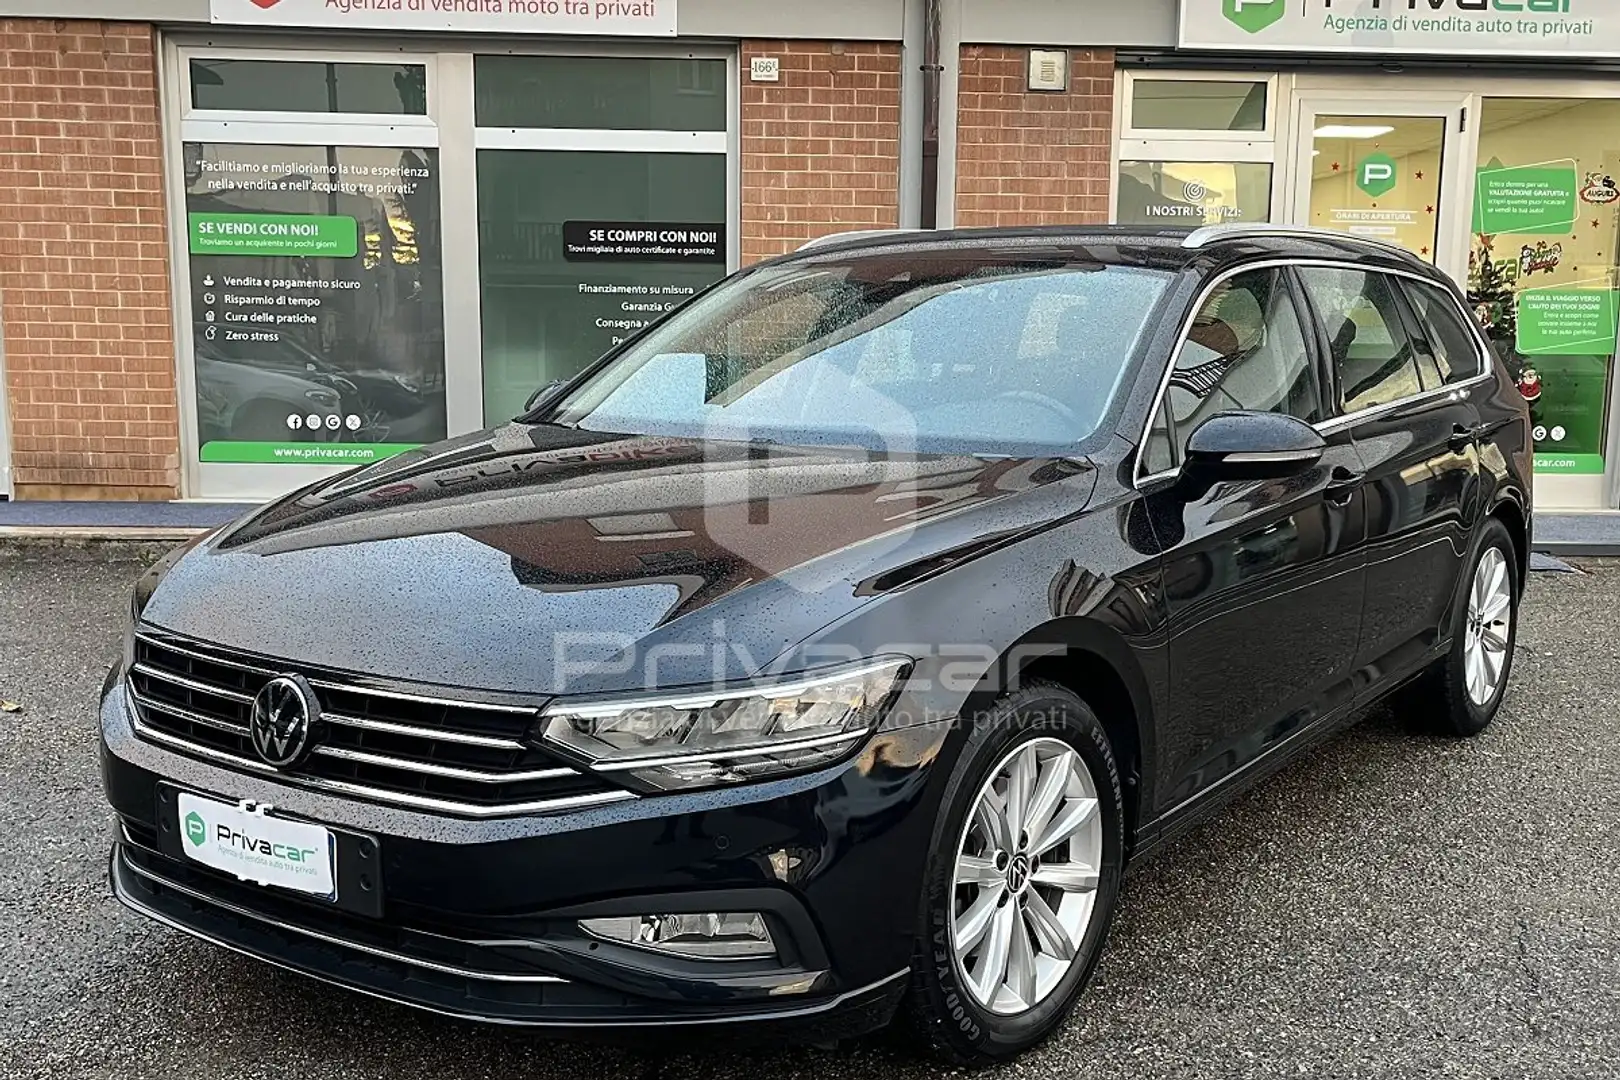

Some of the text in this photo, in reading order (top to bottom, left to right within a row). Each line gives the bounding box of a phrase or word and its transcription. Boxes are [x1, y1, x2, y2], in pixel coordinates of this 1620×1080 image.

[432, 0, 501, 13] vendita
[508, 1, 559, 14] moto
[565, 1, 589, 15] tra
[596, 1, 655, 19] privati
[1324, 14, 1593, 37] Agenzia di vendita auto tra privati
[262, 164, 269, 173] e
[271, 162, 337, 179] miglioriamo
[338, 164, 349, 175] la
[351, 165, 369, 176] tua
[371, 165, 429, 181] esperienza
[208, 179, 235, 190] nella
[235, 179, 278, 191] vendita
[280, 183, 287, 191] e
[359, 183, 374, 193] tra
[1533, 189, 1565, 197] GRATUITA
[1146, 205, 1150, 216] I
[1152, 205, 1194, 216] NOSTRI
[198, 222, 319, 236] SE VENDI CON NOI!
[199, 237, 233, 245] Troviamo
[246, 239, 284, 248] acquirente
[294, 239, 314, 248] pochi
[315, 240, 337, 249] giorni
[589, 230, 717, 243] SE COMPRI CON NOI!
[568, 244, 586, 252] Trovi
[586, 245, 614, 255] migliaia
[615, 245, 623, 253] di
[624, 246, 641, 254] auto
[641, 246, 676, 254] certificate
[683, 247, 716, 256] garantite
[223, 276, 361, 290] Vendita e pagamento sicuro
[578, 284, 694, 295] Finanziamento su misura
[224, 294, 321, 308] Risparmio di tempo
[621, 302, 663, 312] Garanzia
[225, 311, 317, 325] Cura delle pratiche
[595, 318, 642, 330] Consegna
[225, 331, 279, 342] Zero stress
[273, 447, 374, 459] www.privacar.com
[217, 823, 315, 863] Privacar
